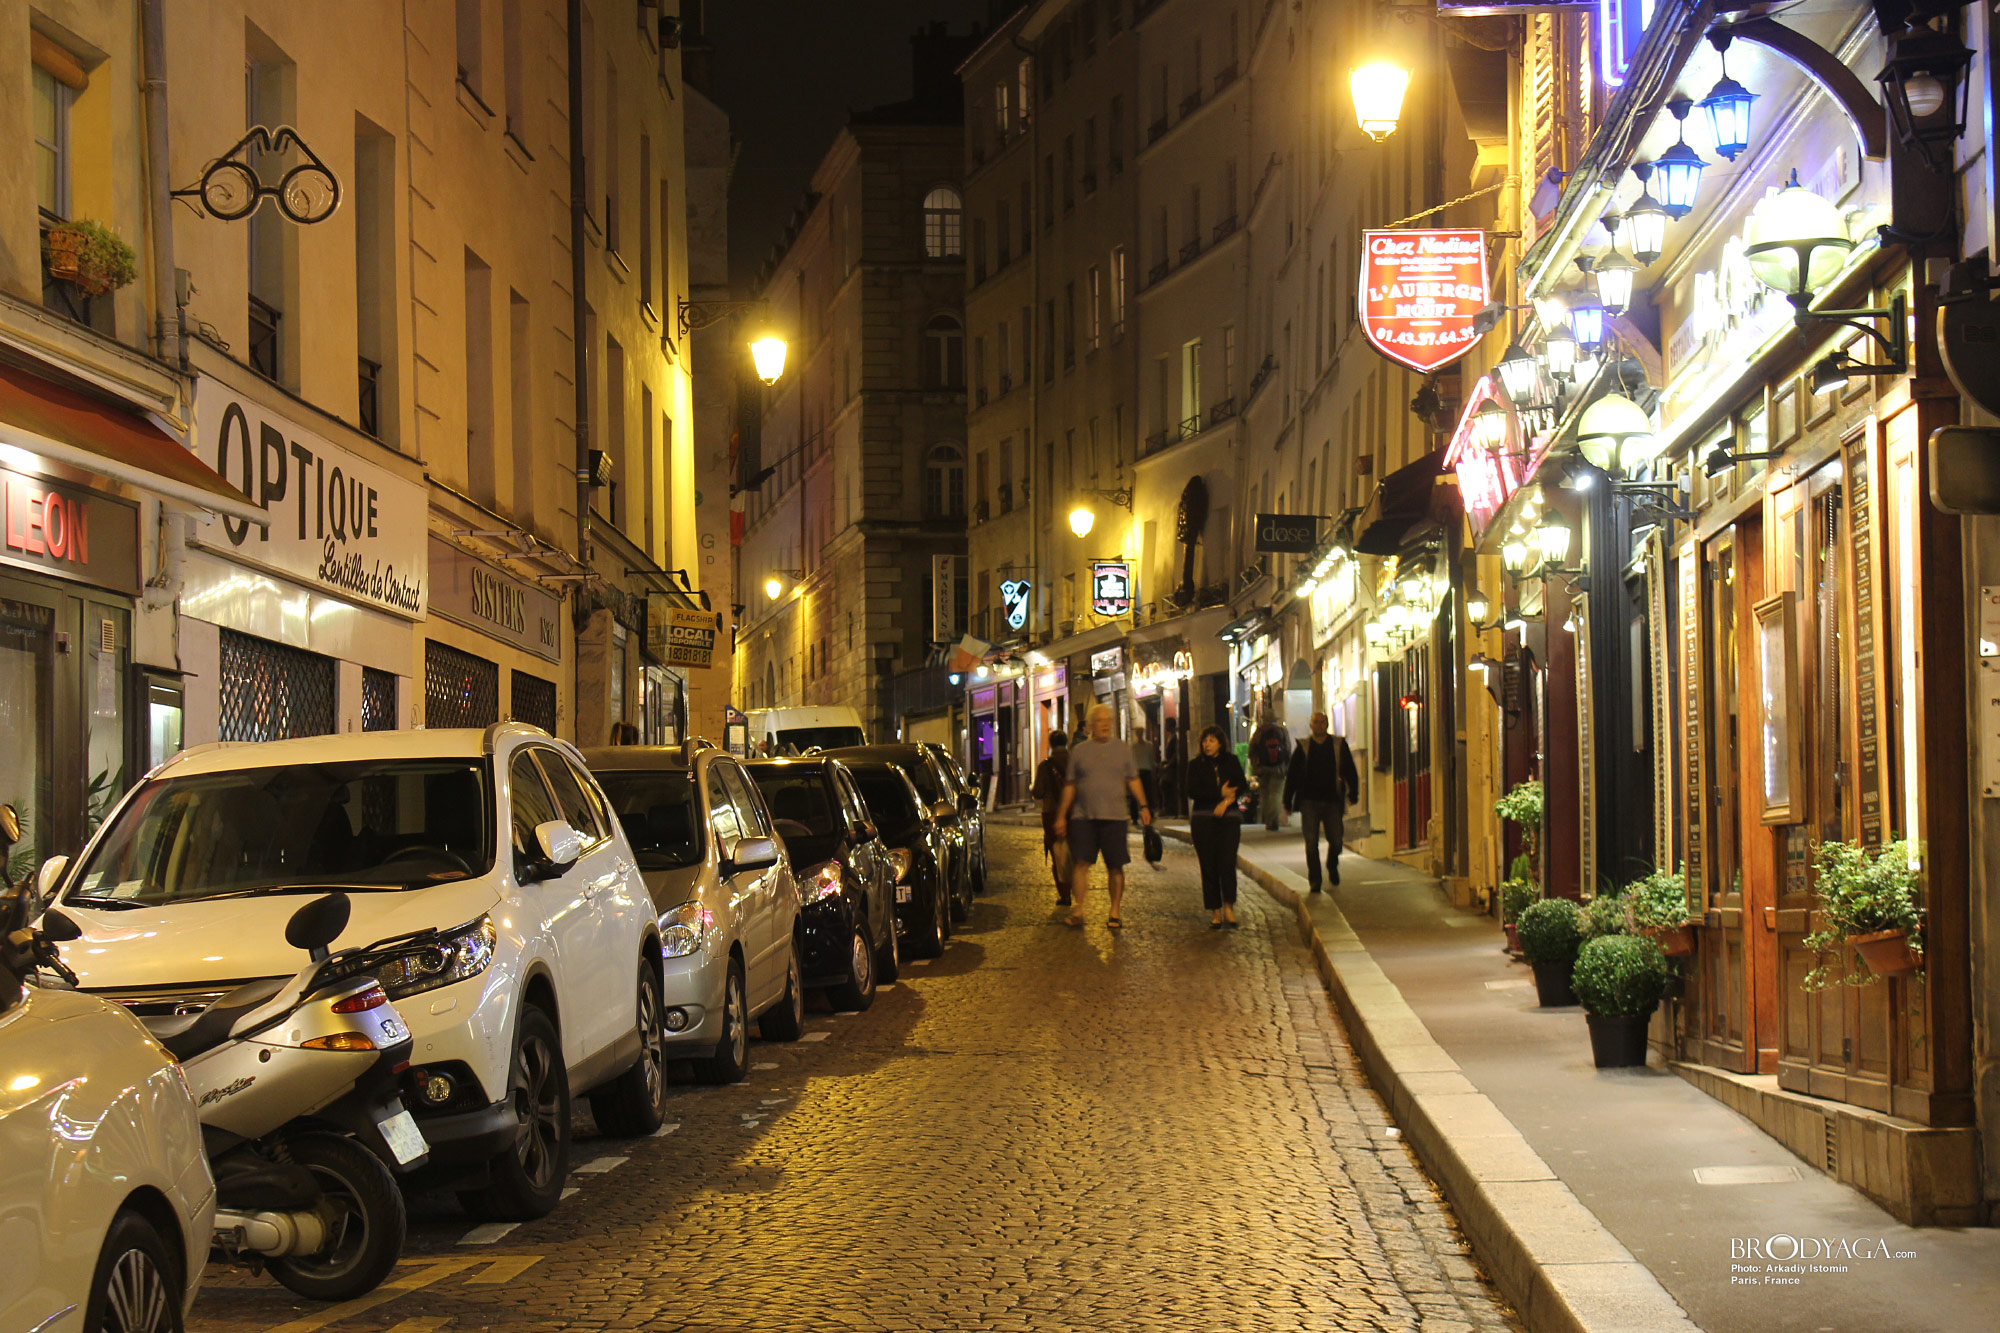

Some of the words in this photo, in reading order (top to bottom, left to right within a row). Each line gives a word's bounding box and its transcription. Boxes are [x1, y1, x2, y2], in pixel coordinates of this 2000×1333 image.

[1371, 238, 1415, 255] Chez
[1416, 237, 1480, 254] Nadine
[1369, 282, 1483, 302] L'AUBERGE
[218, 402, 378, 546] OPTIQUE
[319, 534, 370, 596] Lentilles
[370, 559, 383, 600] de
[384, 564, 420, 613] Contact
[472, 566, 525, 635] SISTERS
[676, 613, 713, 624] FLAGSHIP
[667, 626, 713, 642] LOCAL
